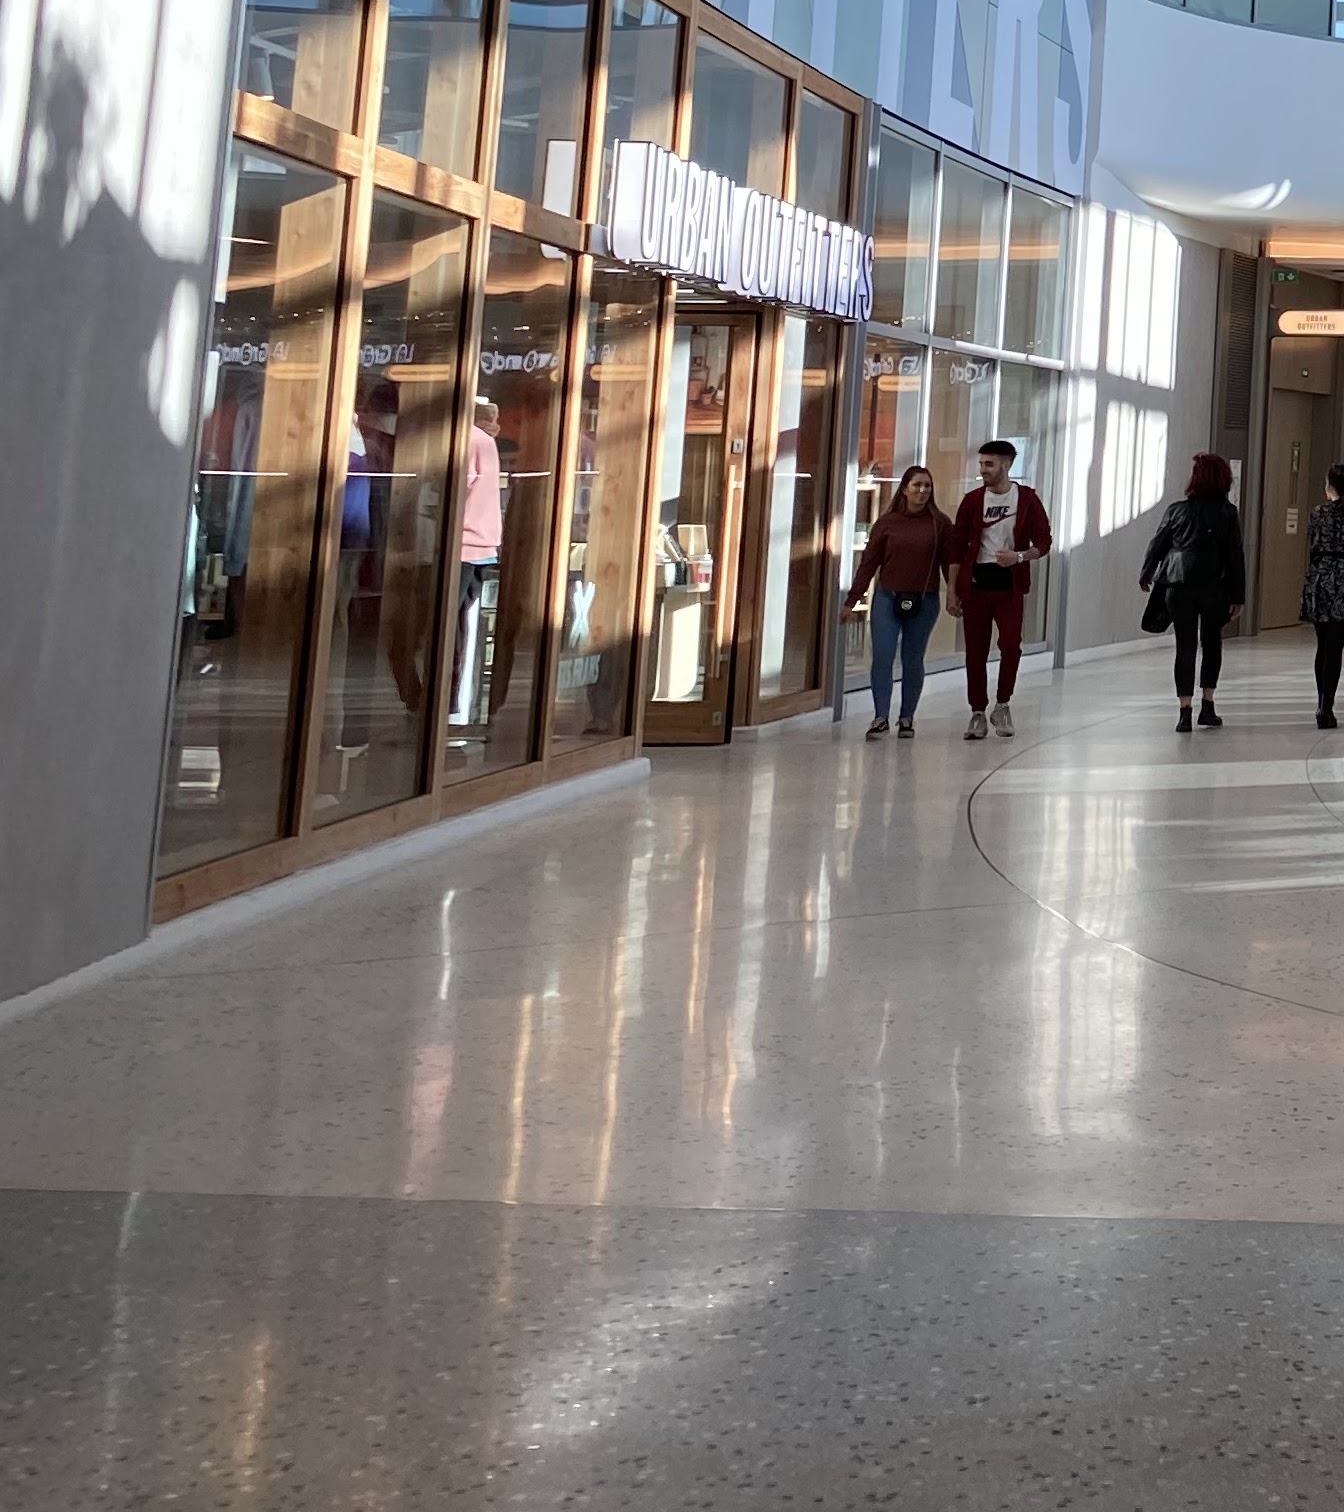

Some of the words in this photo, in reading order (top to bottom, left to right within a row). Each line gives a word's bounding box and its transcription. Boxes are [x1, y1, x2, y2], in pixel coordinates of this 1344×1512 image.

[636, 141, 736, 285] URBAN
[738, 188, 875, 322] OUTFITTERS
[985, 506, 1010, 519] NIKE
